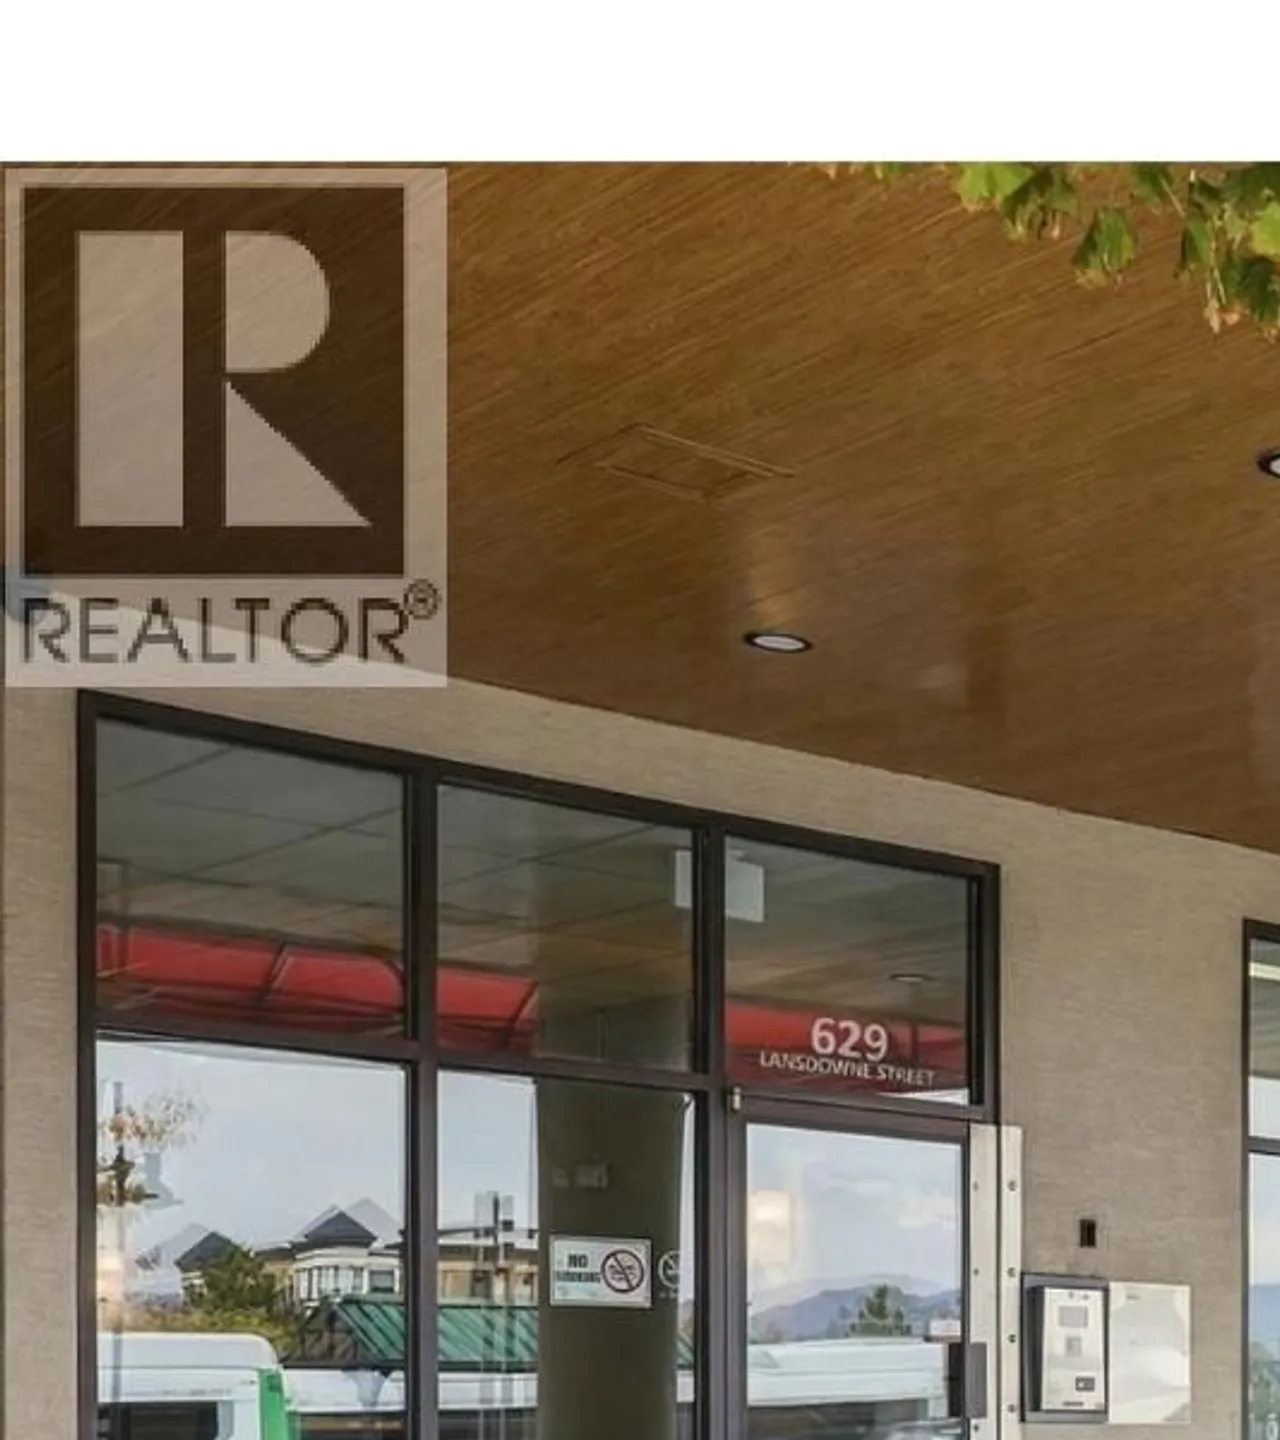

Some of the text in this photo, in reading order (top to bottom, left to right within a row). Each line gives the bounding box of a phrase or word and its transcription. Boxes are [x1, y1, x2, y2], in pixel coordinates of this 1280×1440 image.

[811, 1017, 889, 1062] 629
[760, 1050, 936, 1086] LANSDOWNE STREET
